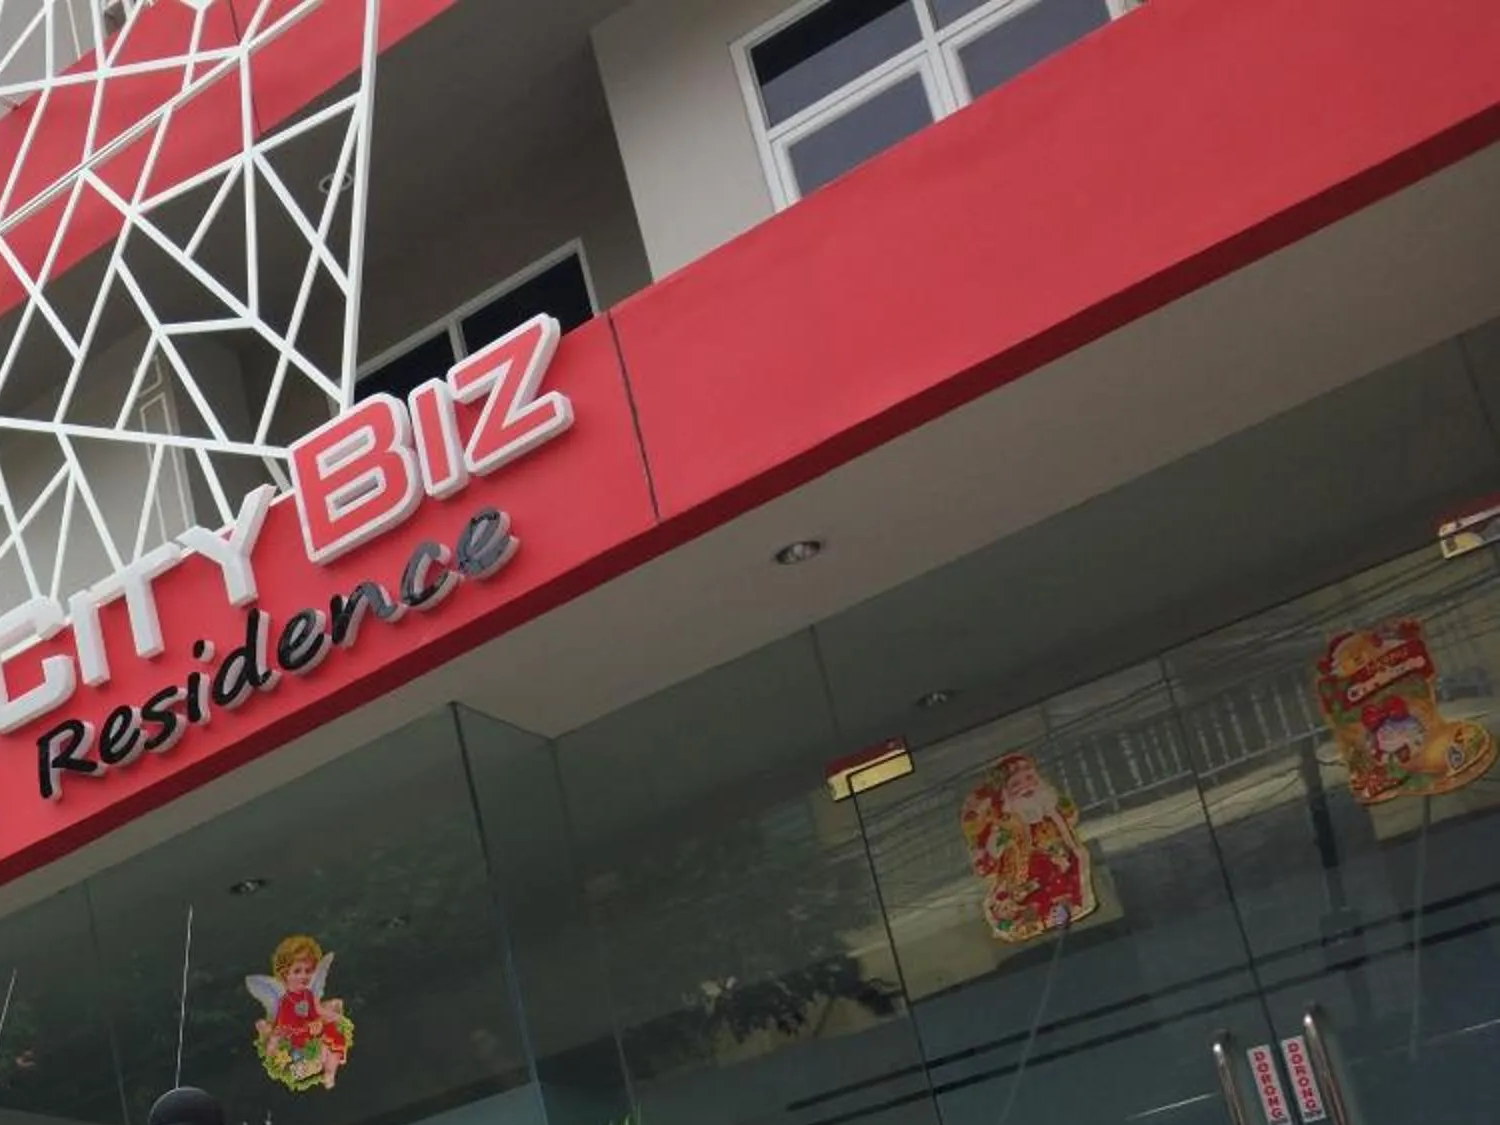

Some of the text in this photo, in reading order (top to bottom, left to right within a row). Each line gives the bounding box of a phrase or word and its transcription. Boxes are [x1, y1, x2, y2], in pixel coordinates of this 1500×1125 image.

[289, 312, 575, 565] BIZ
[36, 506, 521, 800] Residence
[1254, 1051, 1282, 1118] DORONG
[1287, 1042, 1316, 1109] DORONG
